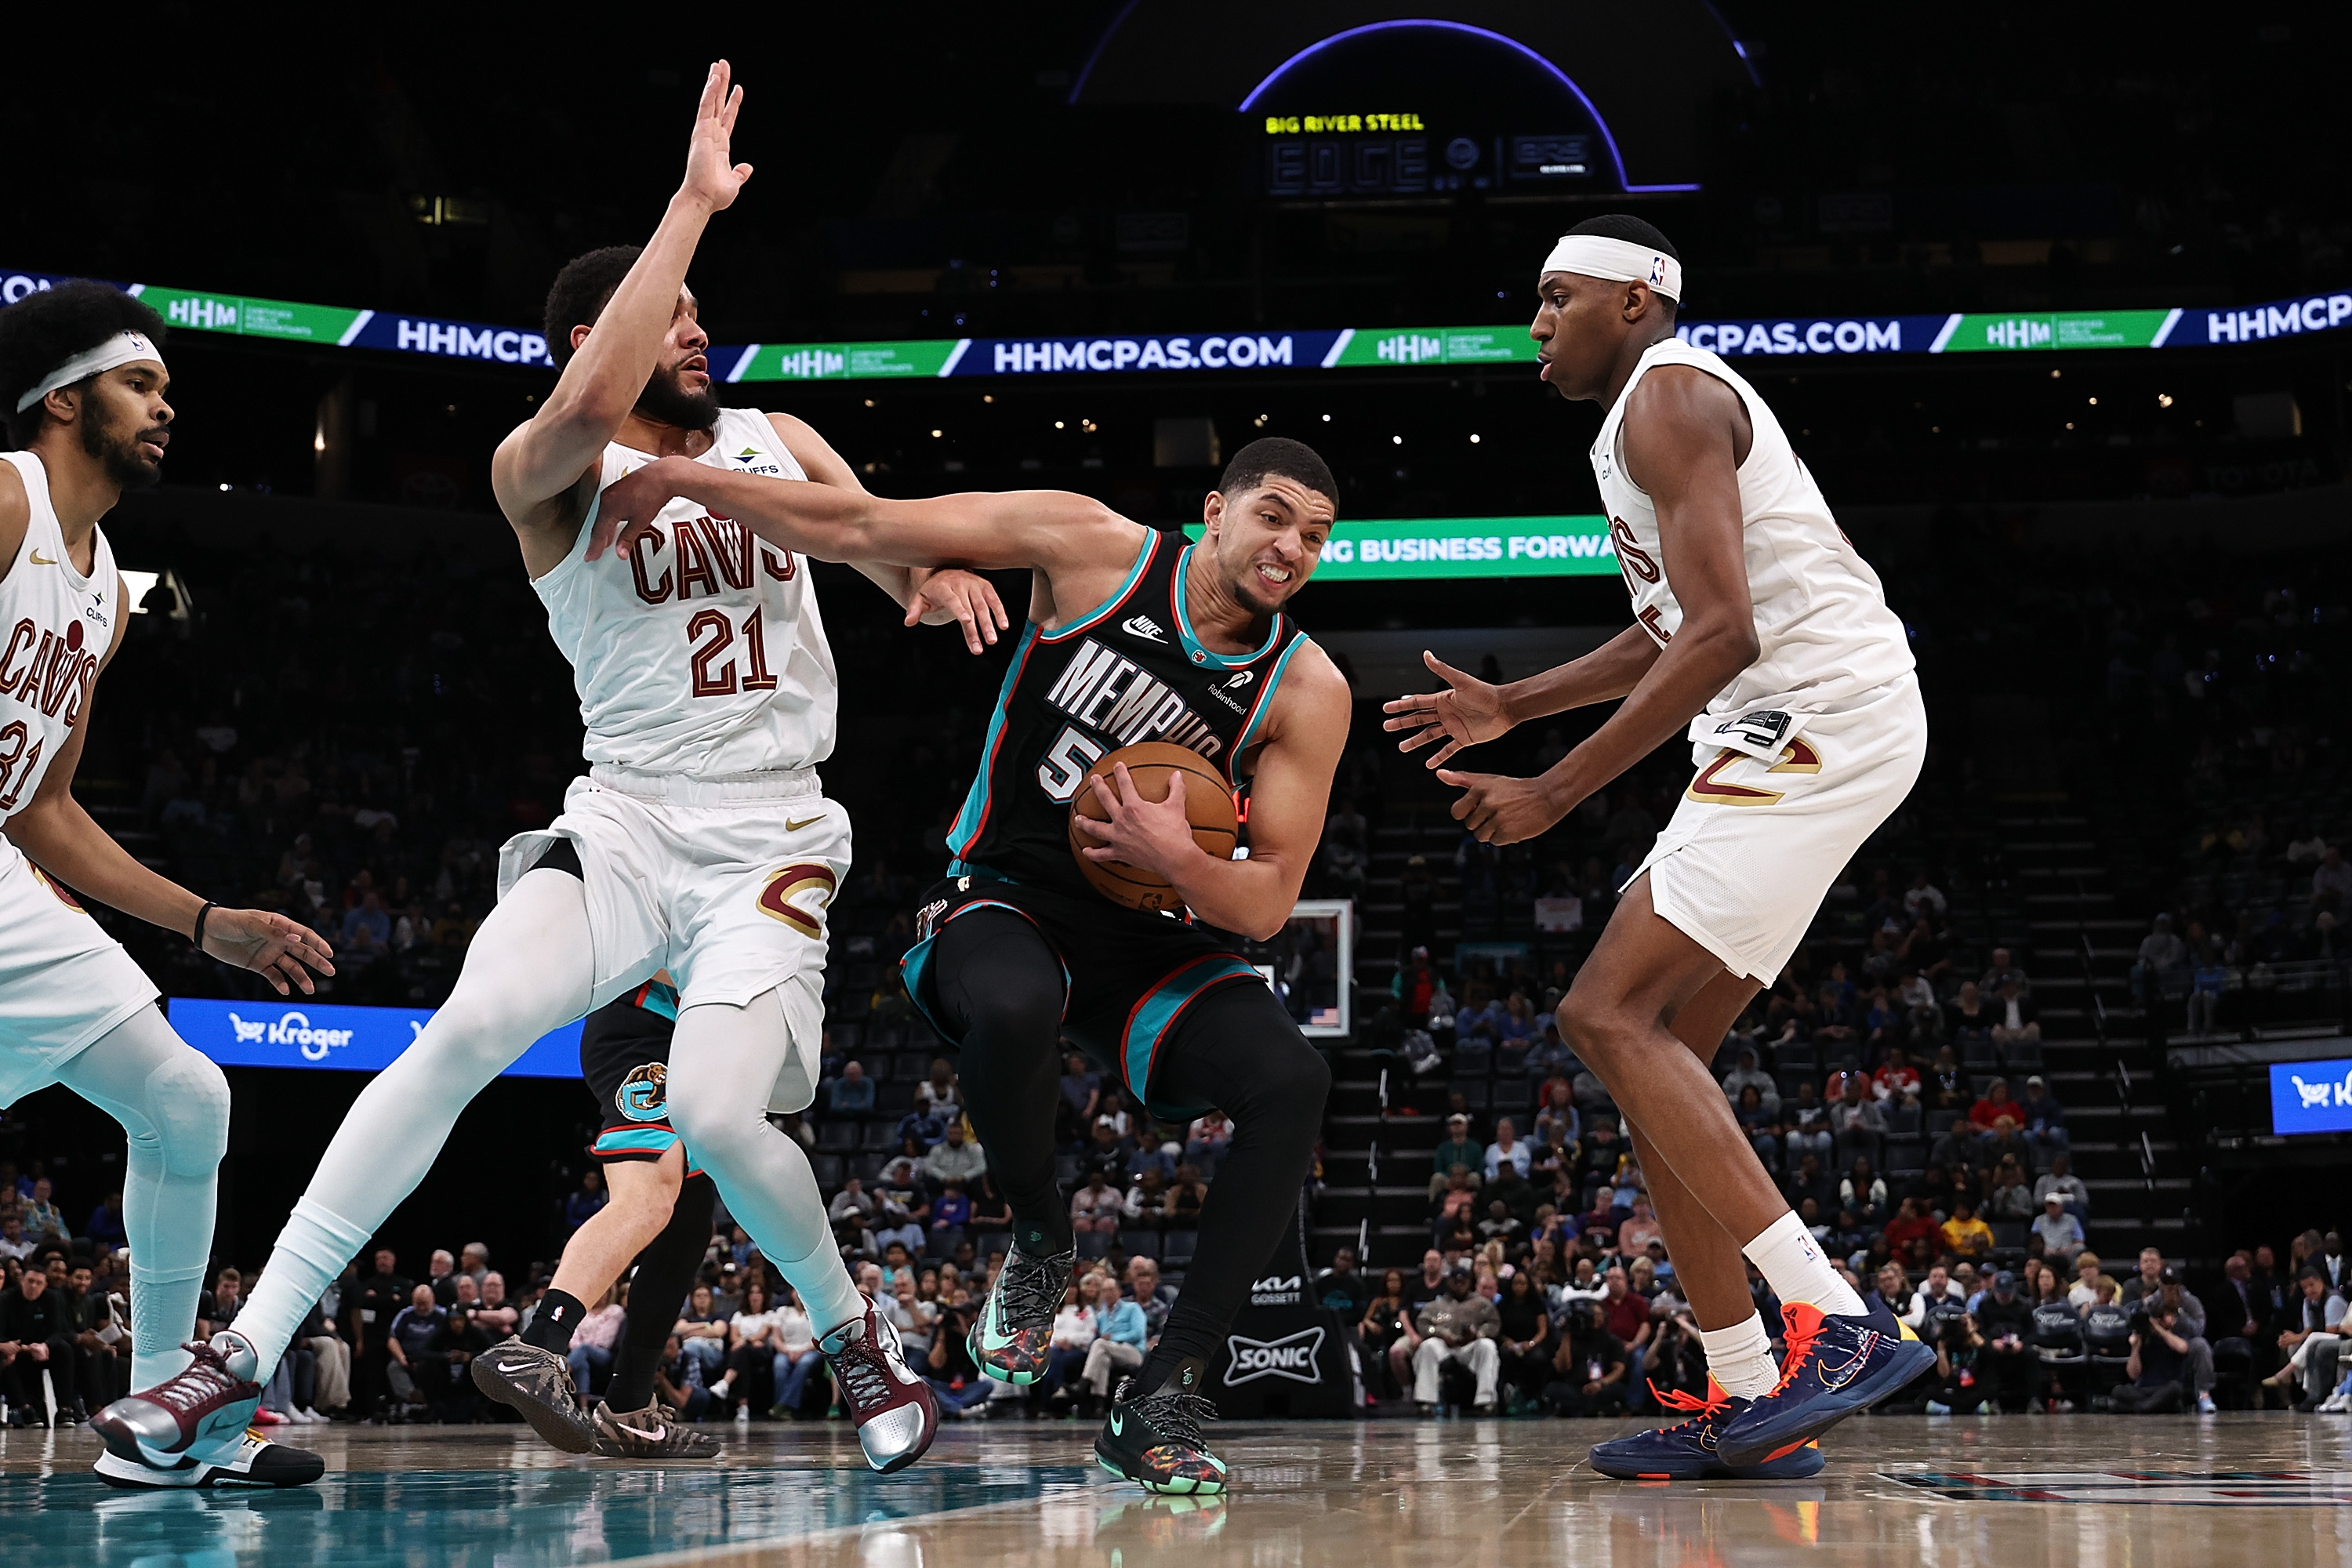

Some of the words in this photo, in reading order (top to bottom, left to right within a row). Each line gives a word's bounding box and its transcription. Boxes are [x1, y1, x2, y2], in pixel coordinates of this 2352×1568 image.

[1265, 116, 1301, 134] BIG
[1304, 114, 1363, 133] RIVER
[1365, 113, 1425, 132] STEEL
[169, 298, 237, 328] HHM
[2208, 294, 2352, 343] HHMCP
[397, 319, 554, 365] HHMCP
[1377, 334, 1441, 363] HHM
[1987, 319, 2050, 349] HHM
[782, 349, 844, 378] HHM
[994, 335, 1294, 373] HHMCPAS.COM
[1360, 535, 1502, 563] BUSINESS
[1131, 615, 1163, 638] NIKE
[686, 603, 778, 699] 21
[0, 617, 100, 728] CAVS
[1207, 684, 1247, 716] Robinhood
[1035, 720, 1110, 804] 5
[268, 1011, 354, 1061] Kroger
[1236, 1346, 1310, 1370] SONIC
